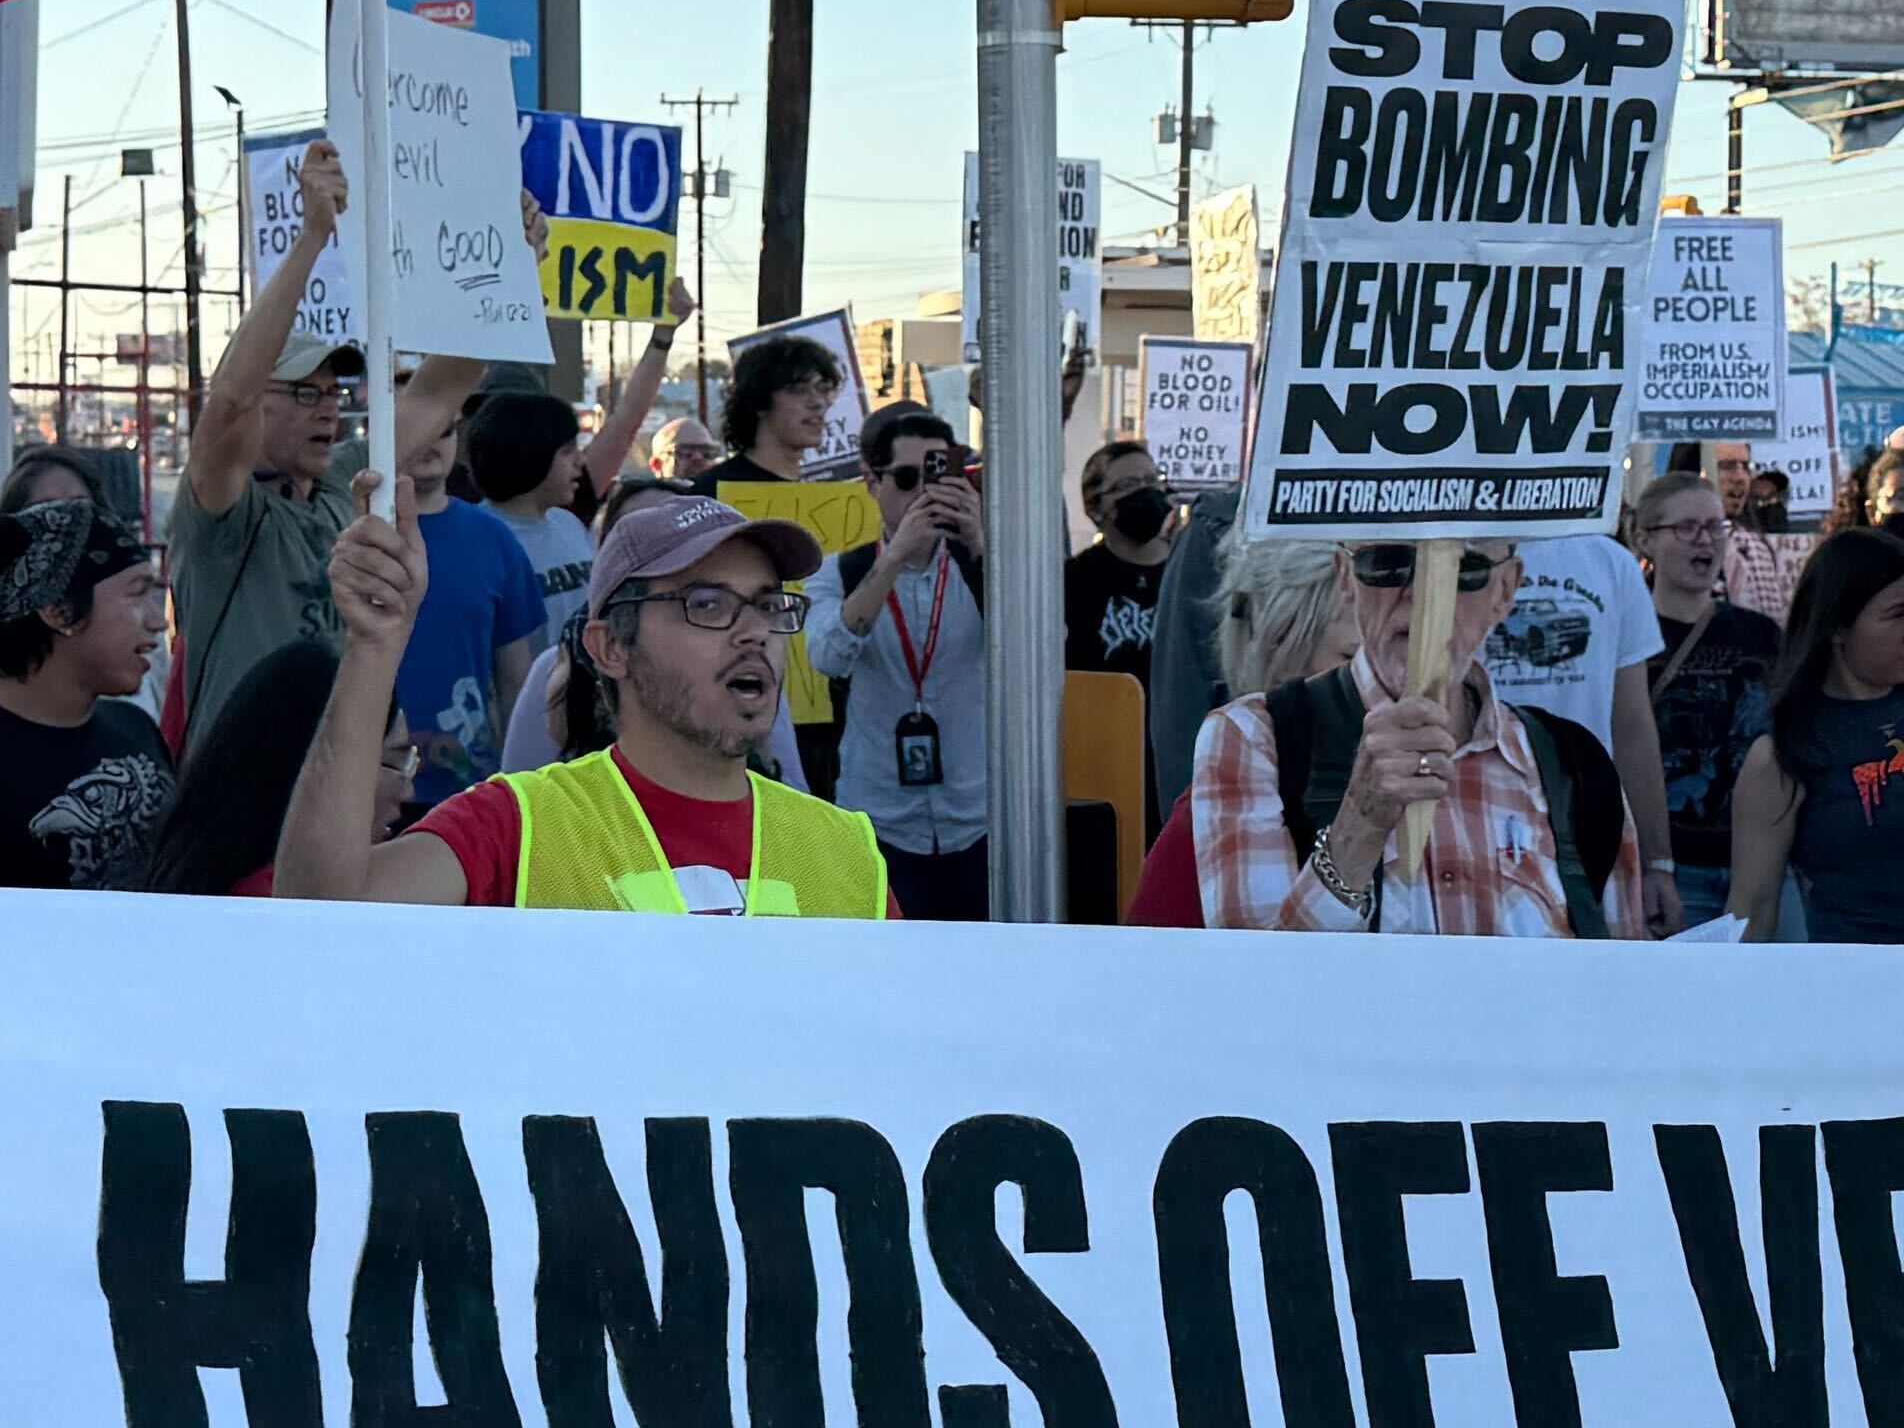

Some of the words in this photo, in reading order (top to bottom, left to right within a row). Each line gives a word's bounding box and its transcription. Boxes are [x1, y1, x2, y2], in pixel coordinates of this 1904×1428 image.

[395, 138, 445, 188] evil
[1308, 85, 1658, 228] BOMBING
[555, 118, 670, 223] NO
[437, 221, 504, 272] GOOD
[1673, 236, 1735, 262] FREE
[544, 244, 666, 318] ISM
[1680, 265, 1729, 293] ALL
[1300, 261, 1626, 371] VENEZUELA
[1653, 296, 1758, 322] PEOPLE
[1181, 355, 1214, 373] NO
[1659, 342, 1716, 360] FROM
[1720, 342, 1752, 360] U.S.
[1158, 373, 1233, 393] BLOOD
[1643, 382, 1770, 400] OCCUPATION
[1148, 392, 1190, 411] FOR
[1199, 393, 1240, 413] OIL!
[1279, 382, 1621, 456] NOW!
[1691, 417, 1720, 431] GAY
[1179, 426, 1209, 444] NO
[1158, 443, 1227, 462] MONEY
[1275, 480, 1339, 514] PARTY
[1337, 480, 1378, 513] FOR
[1377, 478, 1476, 512] SOCIALISM
[1475, 480, 1499, 510] &
[1502, 477, 1603, 510] LIBERATION
